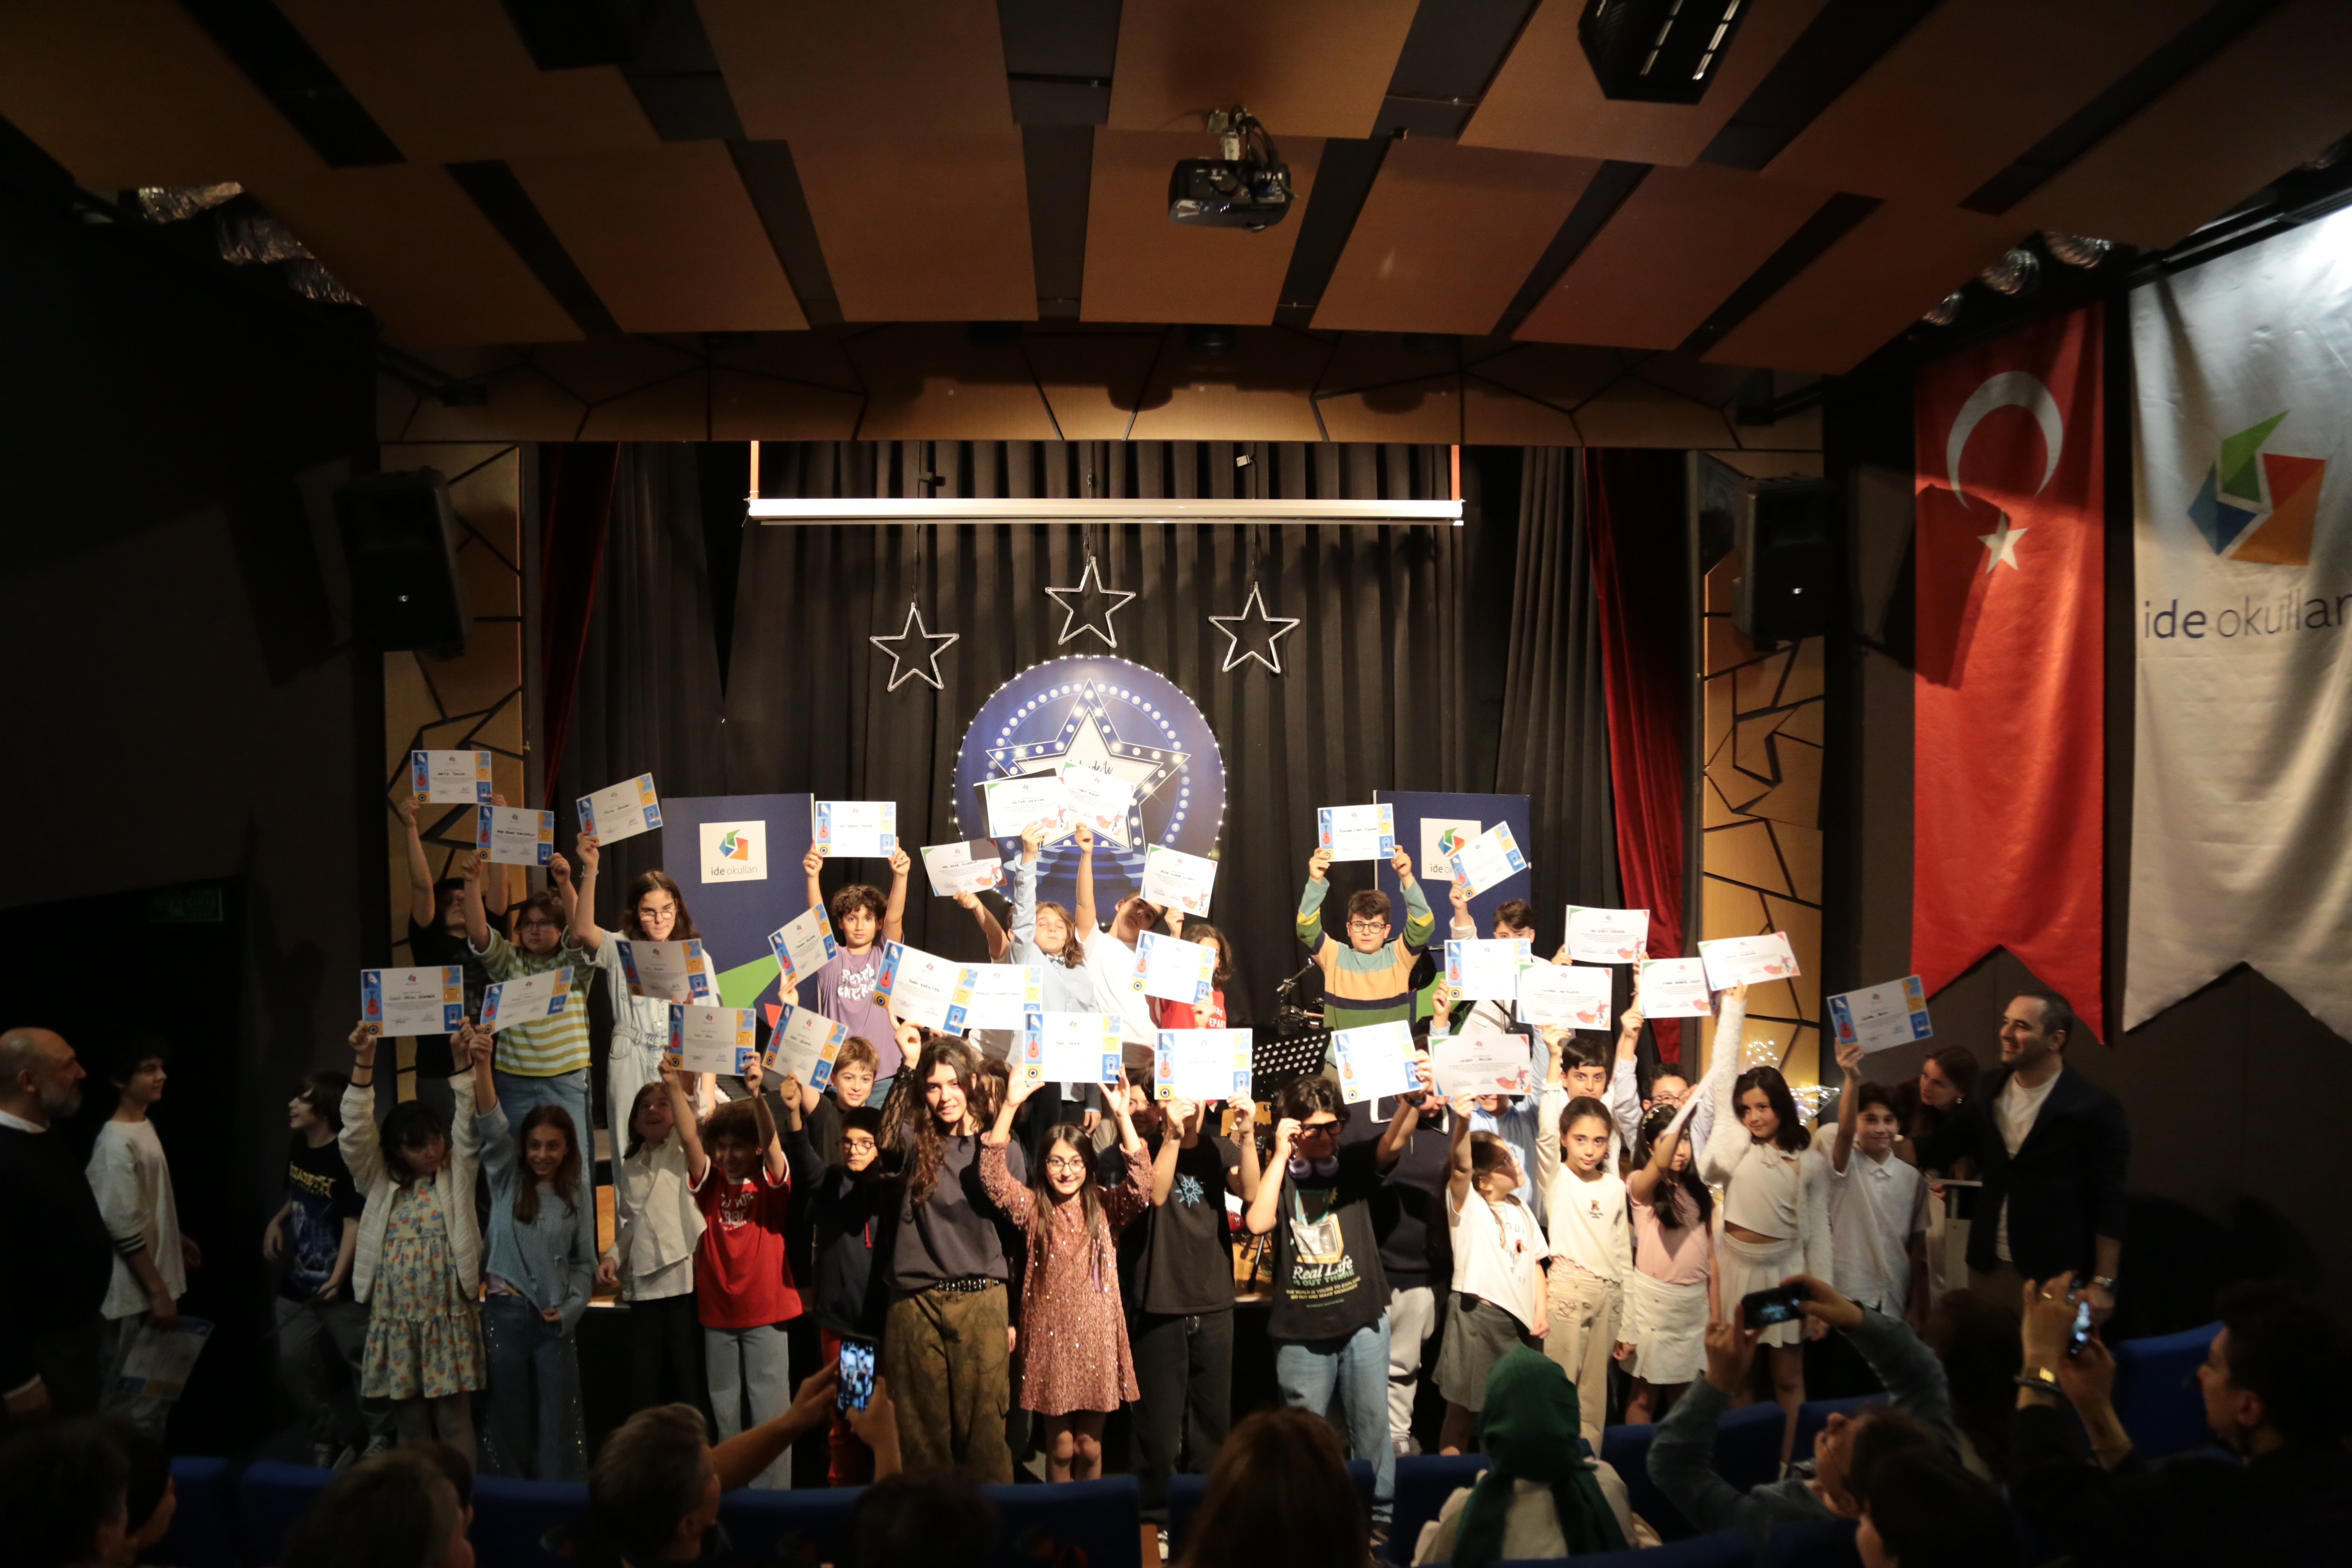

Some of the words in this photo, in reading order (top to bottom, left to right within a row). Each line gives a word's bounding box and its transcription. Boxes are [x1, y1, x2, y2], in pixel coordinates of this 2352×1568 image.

[2144, 598, 2206, 639] ide
[711, 867, 725, 876] ide
[726, 865, 758, 875] okulları
[1430, 863, 1443, 873] ide
[1292, 1264, 1323, 1280] Real
[1324, 1254, 1353, 1277] Life
[1302, 1277, 1322, 1286] OUT
[1323, 1268, 1355, 1283] THERE
